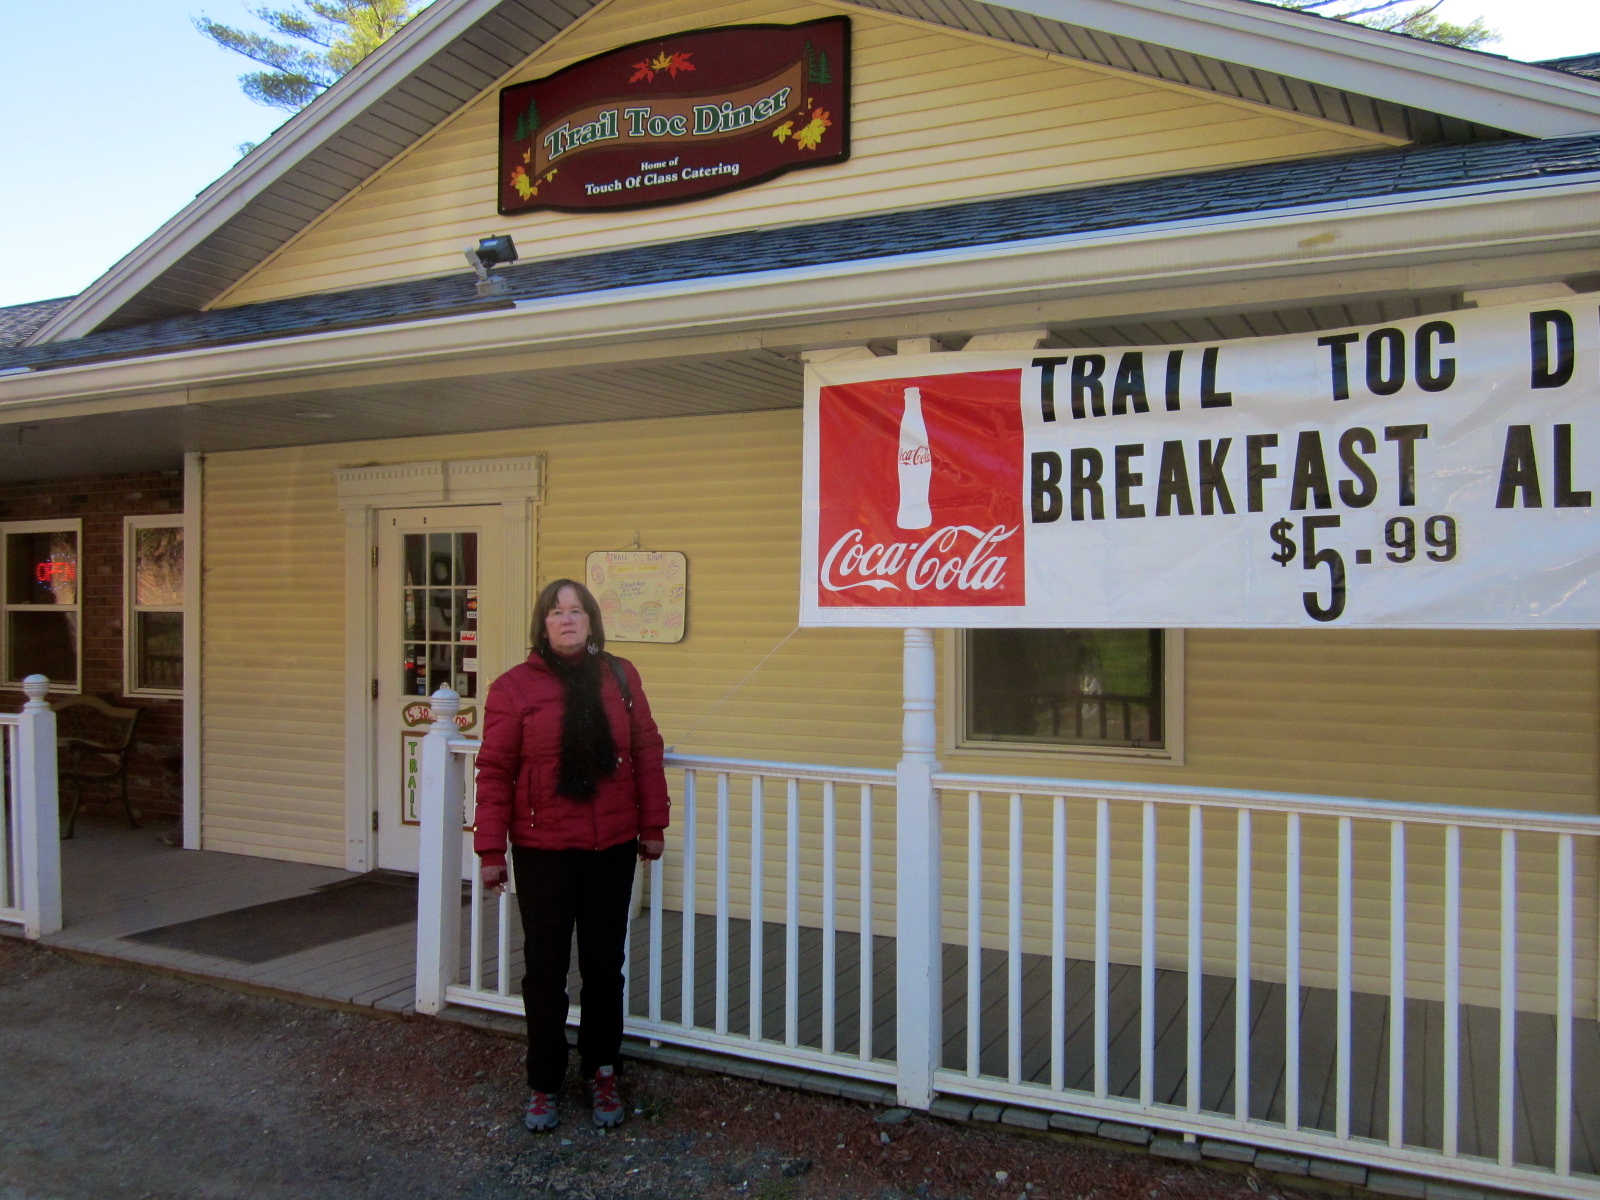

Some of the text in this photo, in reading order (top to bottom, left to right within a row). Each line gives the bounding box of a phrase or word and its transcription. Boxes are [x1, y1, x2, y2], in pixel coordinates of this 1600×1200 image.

[543, 87, 791, 161] Trail Toc Diner
[585, 162, 740, 196] Touch Of Class Catering
[640, 157, 679, 171] Home of
[1032, 305, 1600, 423] TRAIL TOC D
[1030, 422, 1592, 524] BREAKFAST AL
[820, 524, 1020, 592] Coca-Cola
[1269, 514, 1458, 622] $5.99
[408, 741, 418, 819] TRAIL
